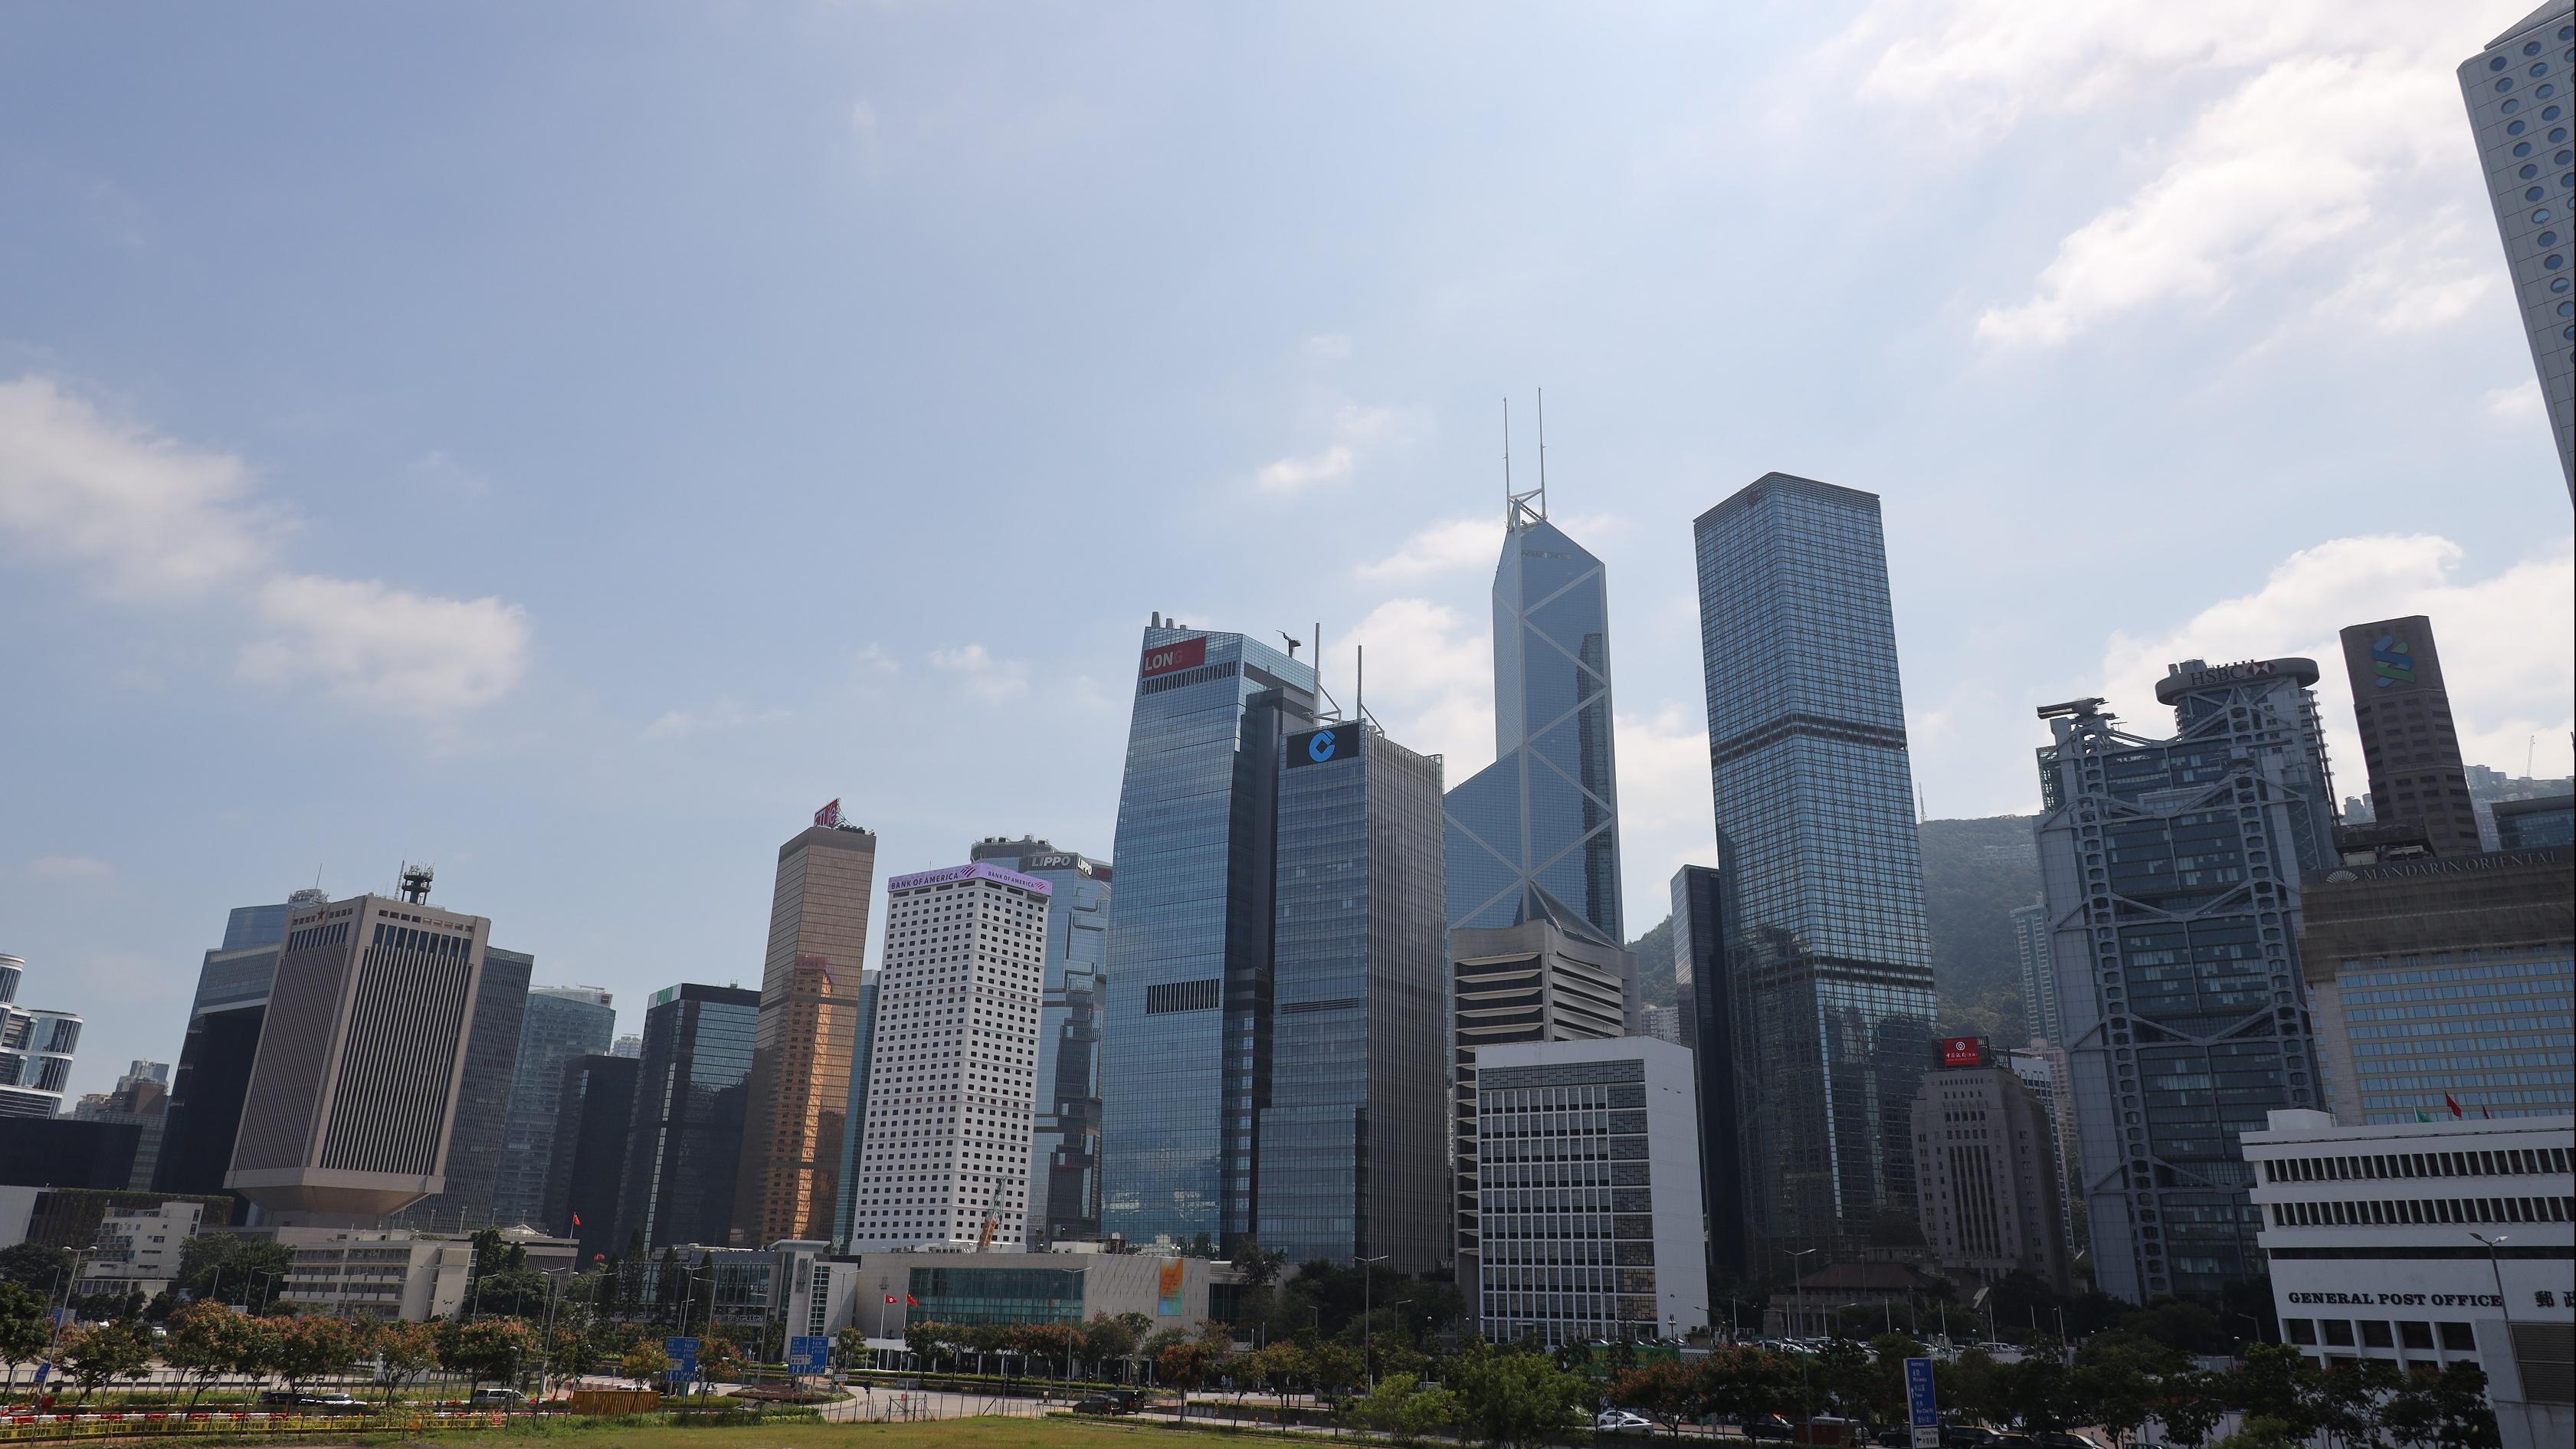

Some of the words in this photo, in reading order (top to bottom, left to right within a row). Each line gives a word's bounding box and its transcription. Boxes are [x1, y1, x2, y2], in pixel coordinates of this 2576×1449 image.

[2189, 664, 2244, 686] HSBC
[1031, 856, 1071, 867] LIPPO
[1077, 857, 1093, 876] LIPPO
[2362, 860, 2462, 881] MANDARIN
[891, 880, 912, 890] BANK
[913, 877, 923, 887] OF
[923, 872, 959, 884] AMERICA
[988, 870, 1003, 880] BANK
[1011, 877, 1035, 888] AMERICA
[2289, 1292, 2374, 1305] GENERAL
[2378, 1293, 2426, 1306] POST
[2431, 1293, 2502, 1307] OFFICE
